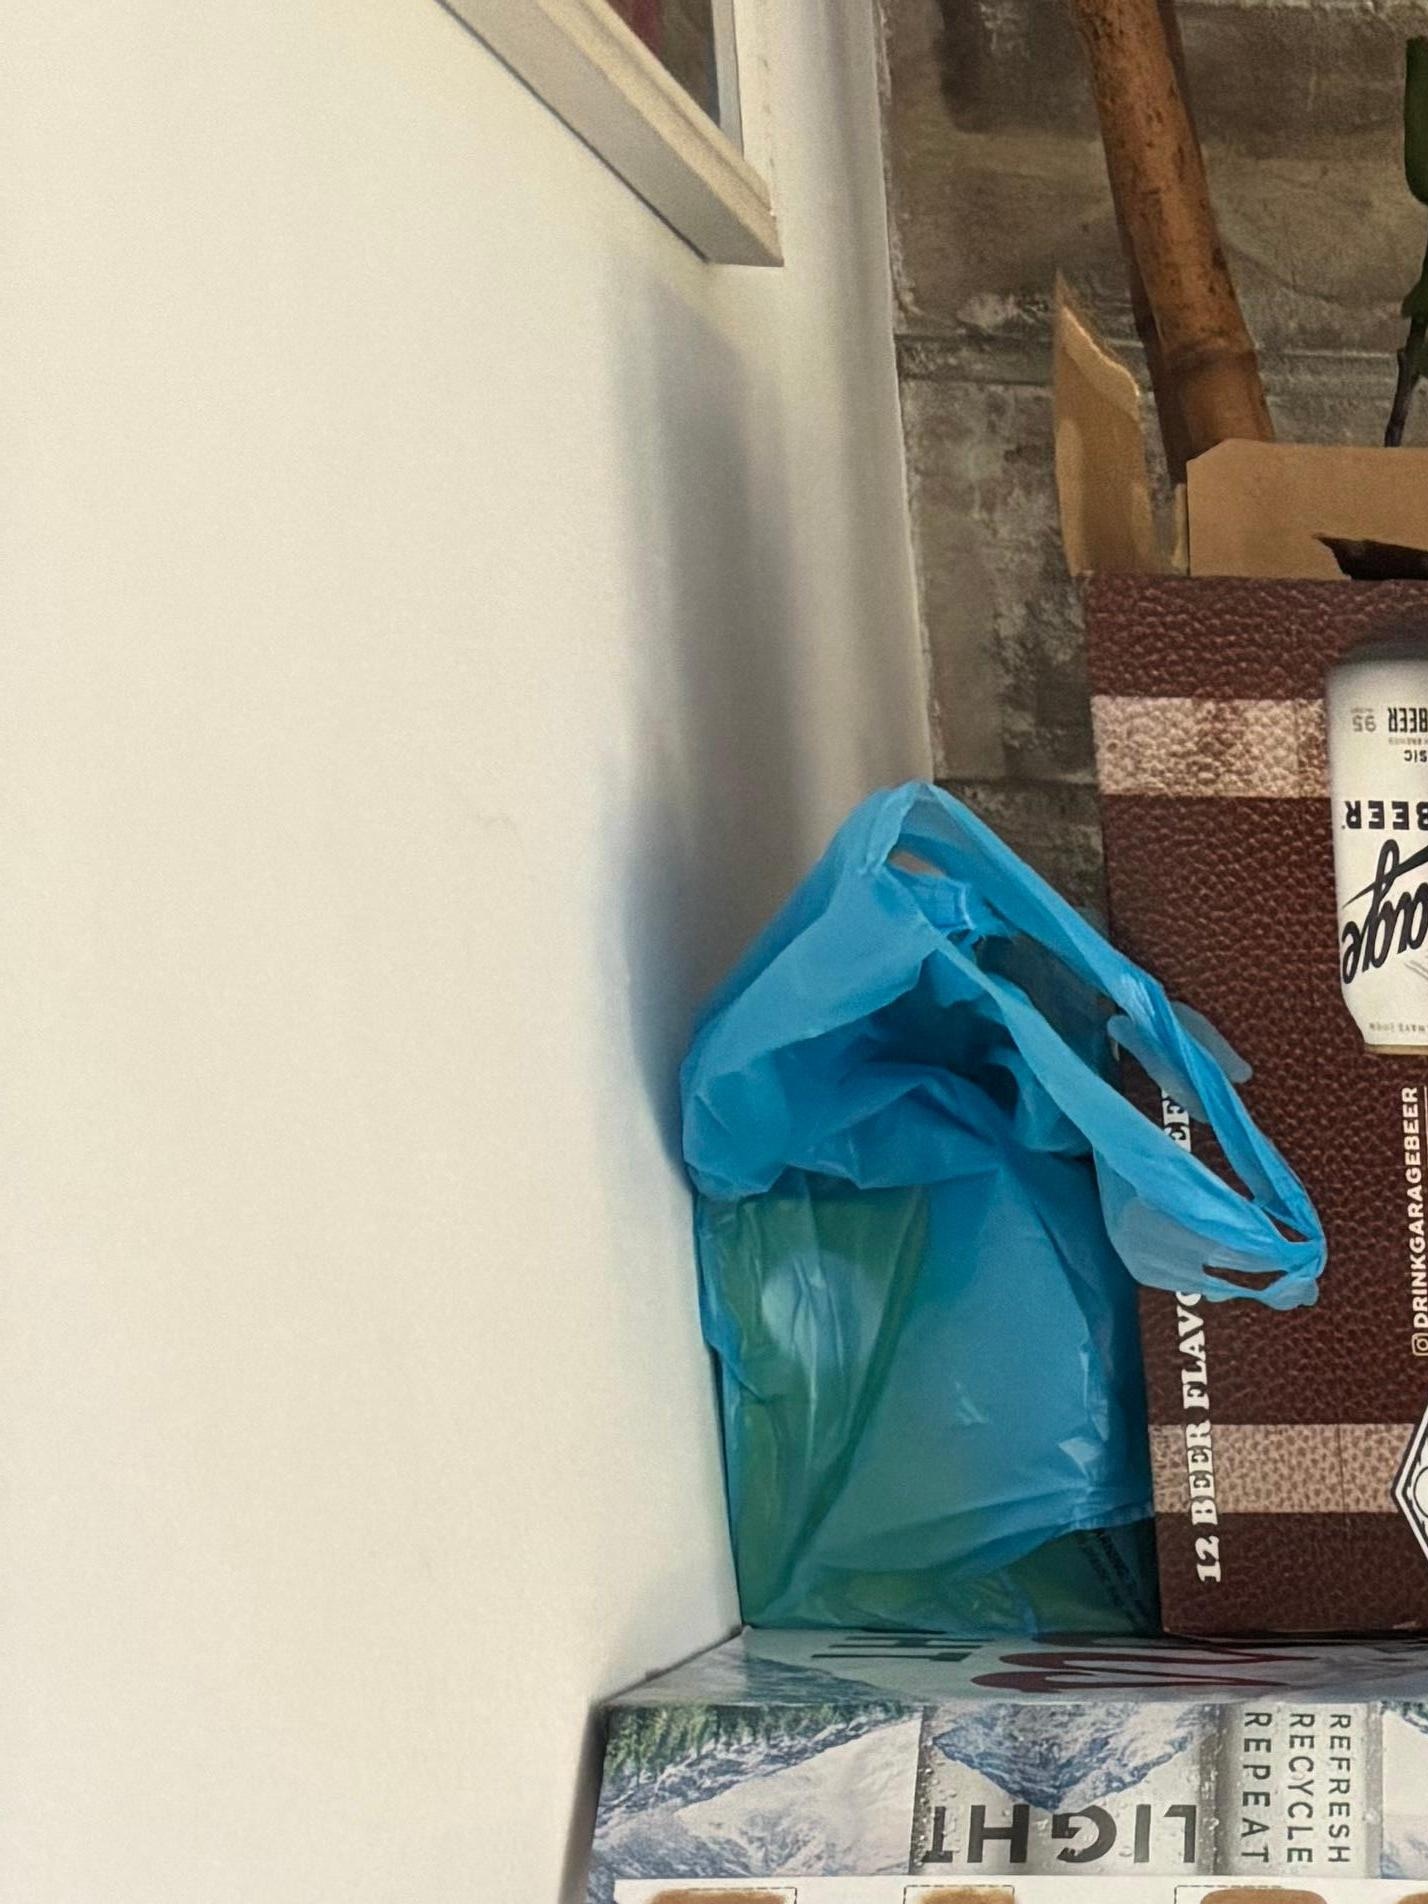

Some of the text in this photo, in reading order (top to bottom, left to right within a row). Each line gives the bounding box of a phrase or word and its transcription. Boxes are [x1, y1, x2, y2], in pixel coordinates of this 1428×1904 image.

[1352, 715, 1377, 732] 95
[1388, 707, 1428, 733] BEER
[1185, 1418, 1221, 1529] BEER
[1195, 1536, 1221, 1583] 12
[1240, 1712, 1273, 1864] REPEAT
[1286, 1712, 1315, 1864] RECYCLE
[1327, 1713, 1352, 1865] REFRESH
[923, 1804, 1197, 1865] LIGHT
